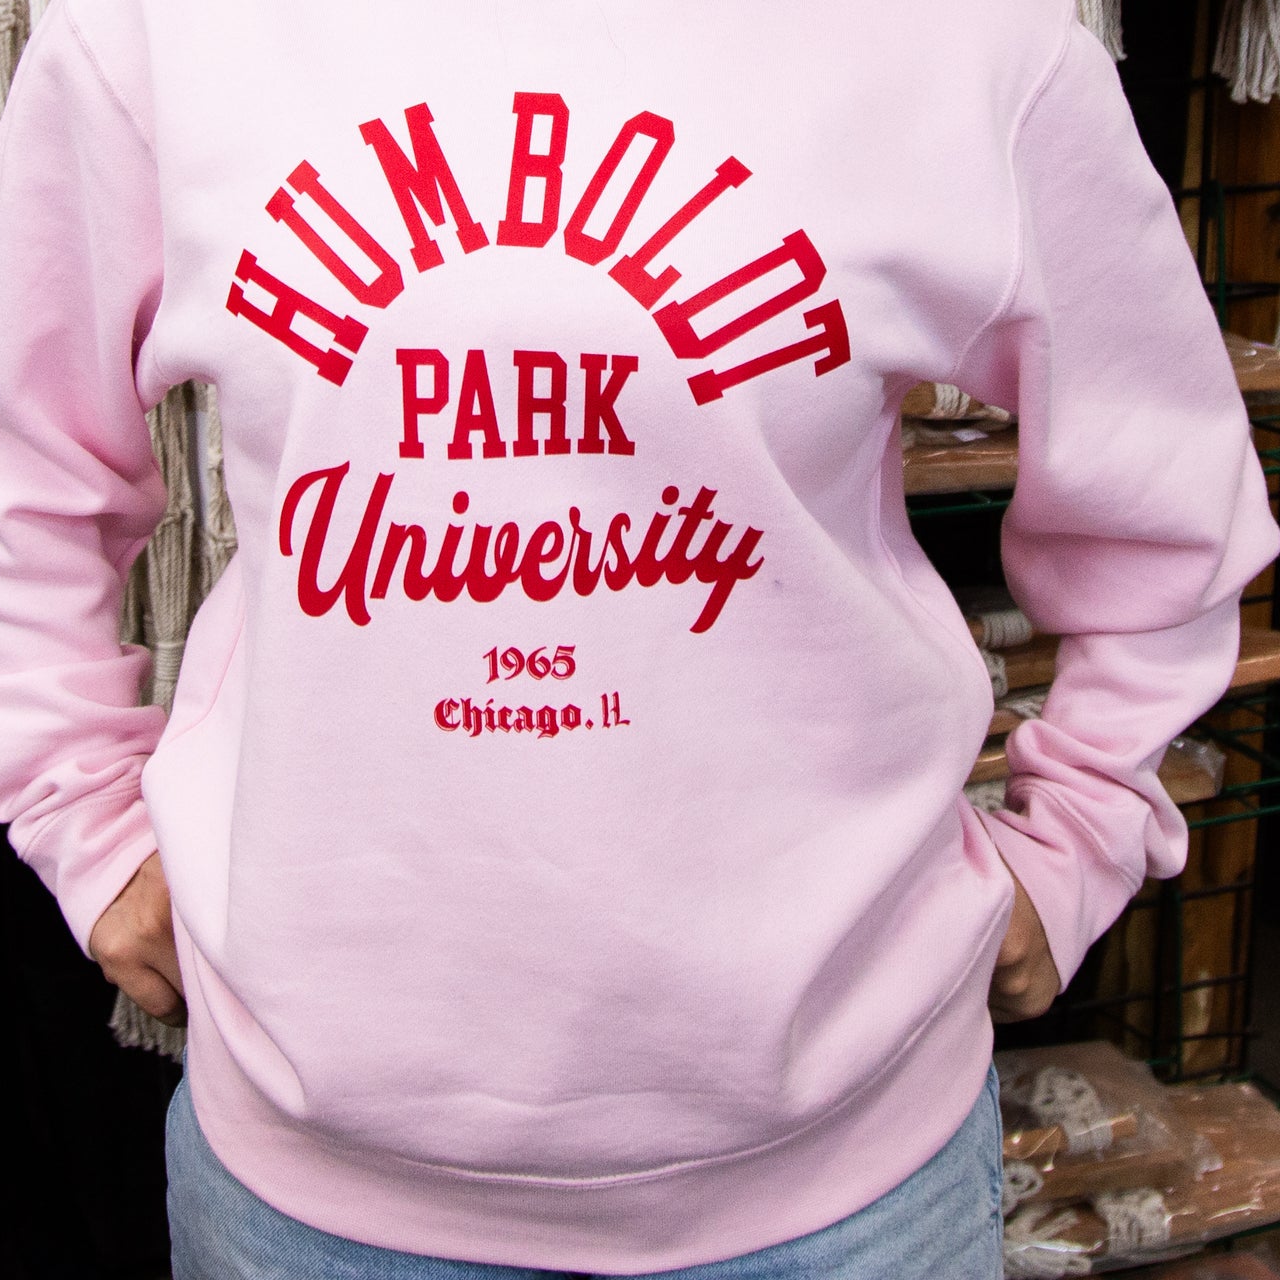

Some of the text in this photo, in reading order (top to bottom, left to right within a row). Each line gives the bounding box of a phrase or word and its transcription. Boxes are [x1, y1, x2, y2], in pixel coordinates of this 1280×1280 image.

[226, 92, 851, 406] HUMBOLDT
[396, 348, 639, 460] PARK
[278, 460, 764, 634] University
[482, 645, 576, 684] 1965
